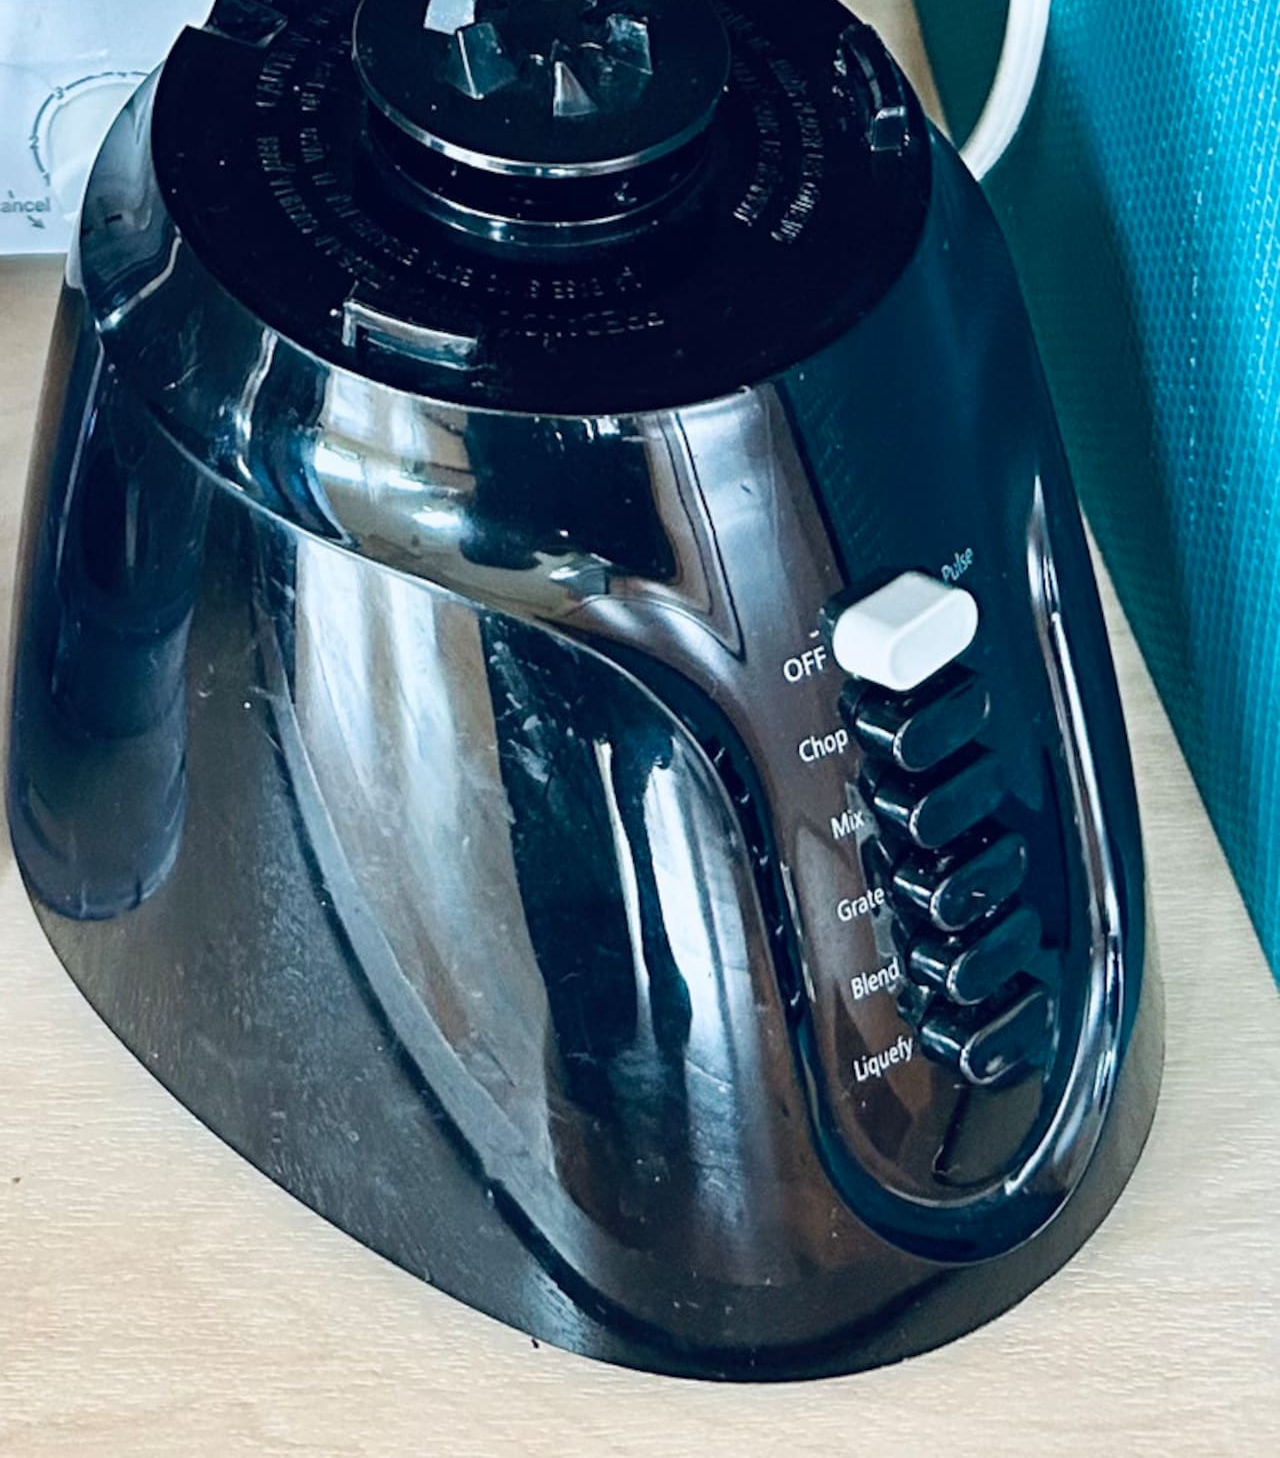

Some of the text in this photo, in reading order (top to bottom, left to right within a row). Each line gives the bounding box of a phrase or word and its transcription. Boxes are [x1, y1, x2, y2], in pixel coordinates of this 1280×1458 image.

[941, 548, 974, 583] Pulse
[782, 645, 827, 683] OFF
[798, 728, 850, 763] Chop
[830, 809, 865, 840] Mix
[837, 887, 885, 922] Grate
[850, 955, 900, 1000] Blend
[853, 1034, 914, 1082] Liquefy
